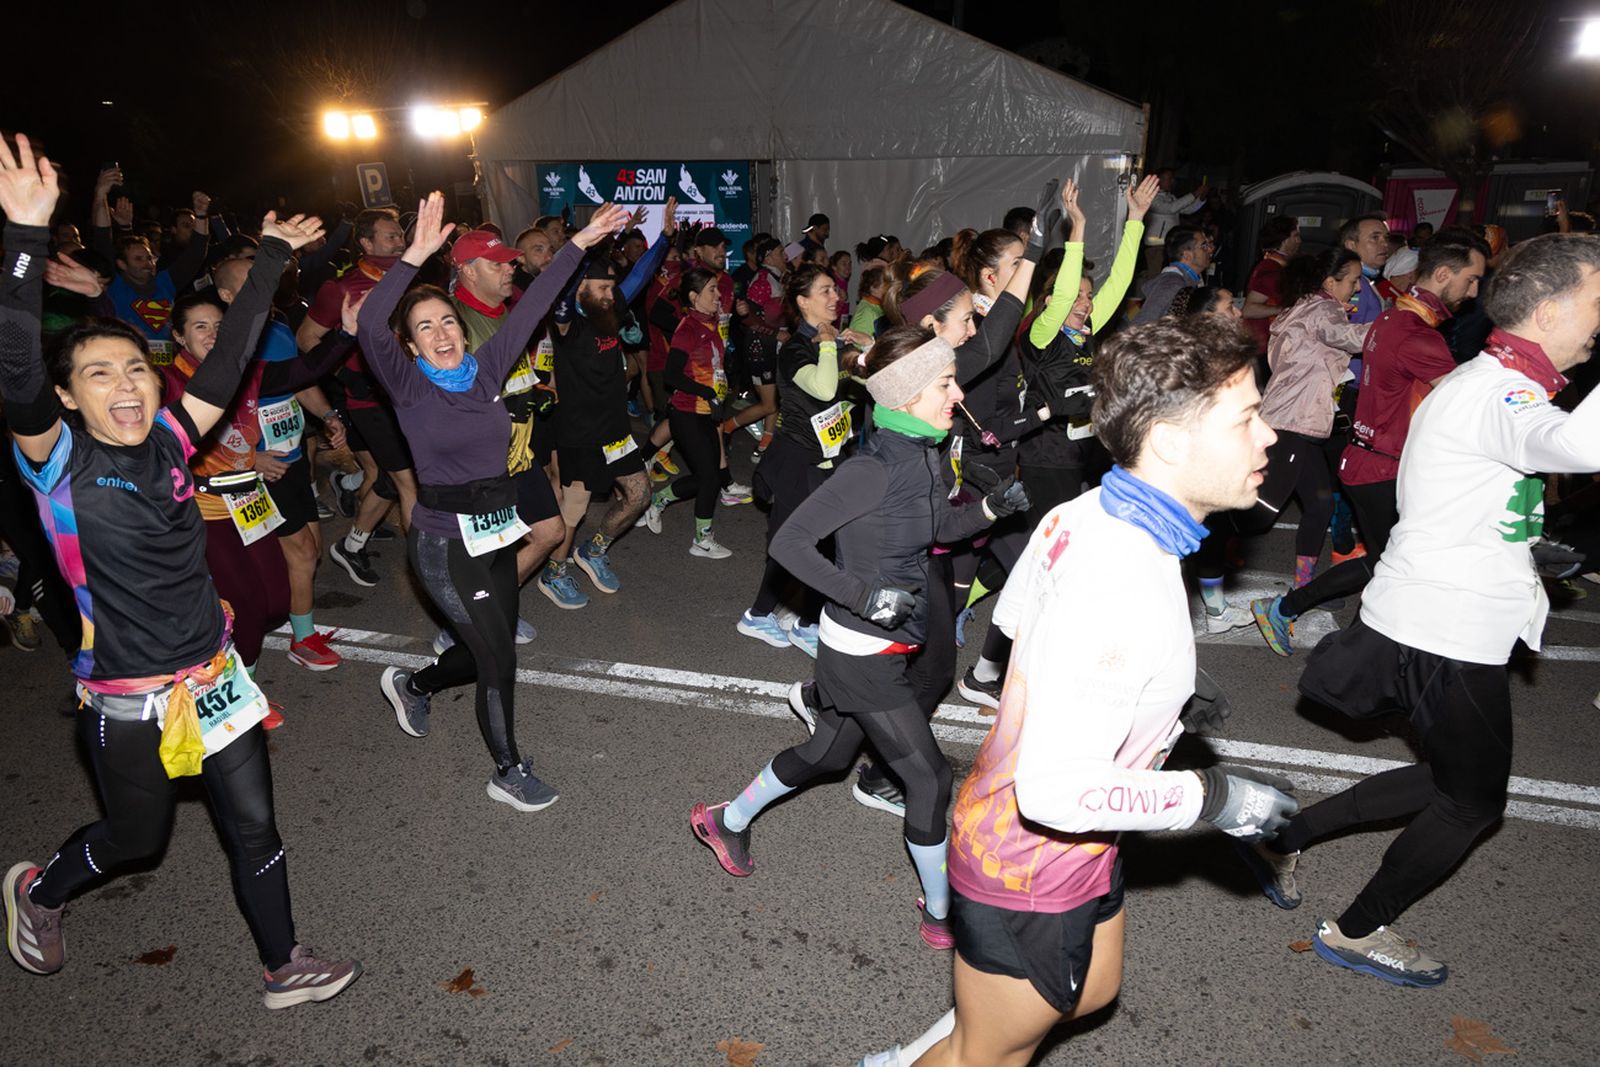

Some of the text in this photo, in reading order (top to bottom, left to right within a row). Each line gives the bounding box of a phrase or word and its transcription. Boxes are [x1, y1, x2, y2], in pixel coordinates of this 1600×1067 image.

[364, 168, 383, 203] P
[616, 168, 668, 185] 43 SAN
[585, 186, 596, 198] 43
[614, 182, 666, 201] ANTÓN
[687, 185, 698, 198] 43
[12, 252, 31, 279] RUN
[272, 414, 300, 438] 8943
[828, 415, 850, 441] 9981
[226, 433, 242, 448] 43
[240, 495, 271, 523] 13621
[1366, 949, 1405, 972] HOKA
